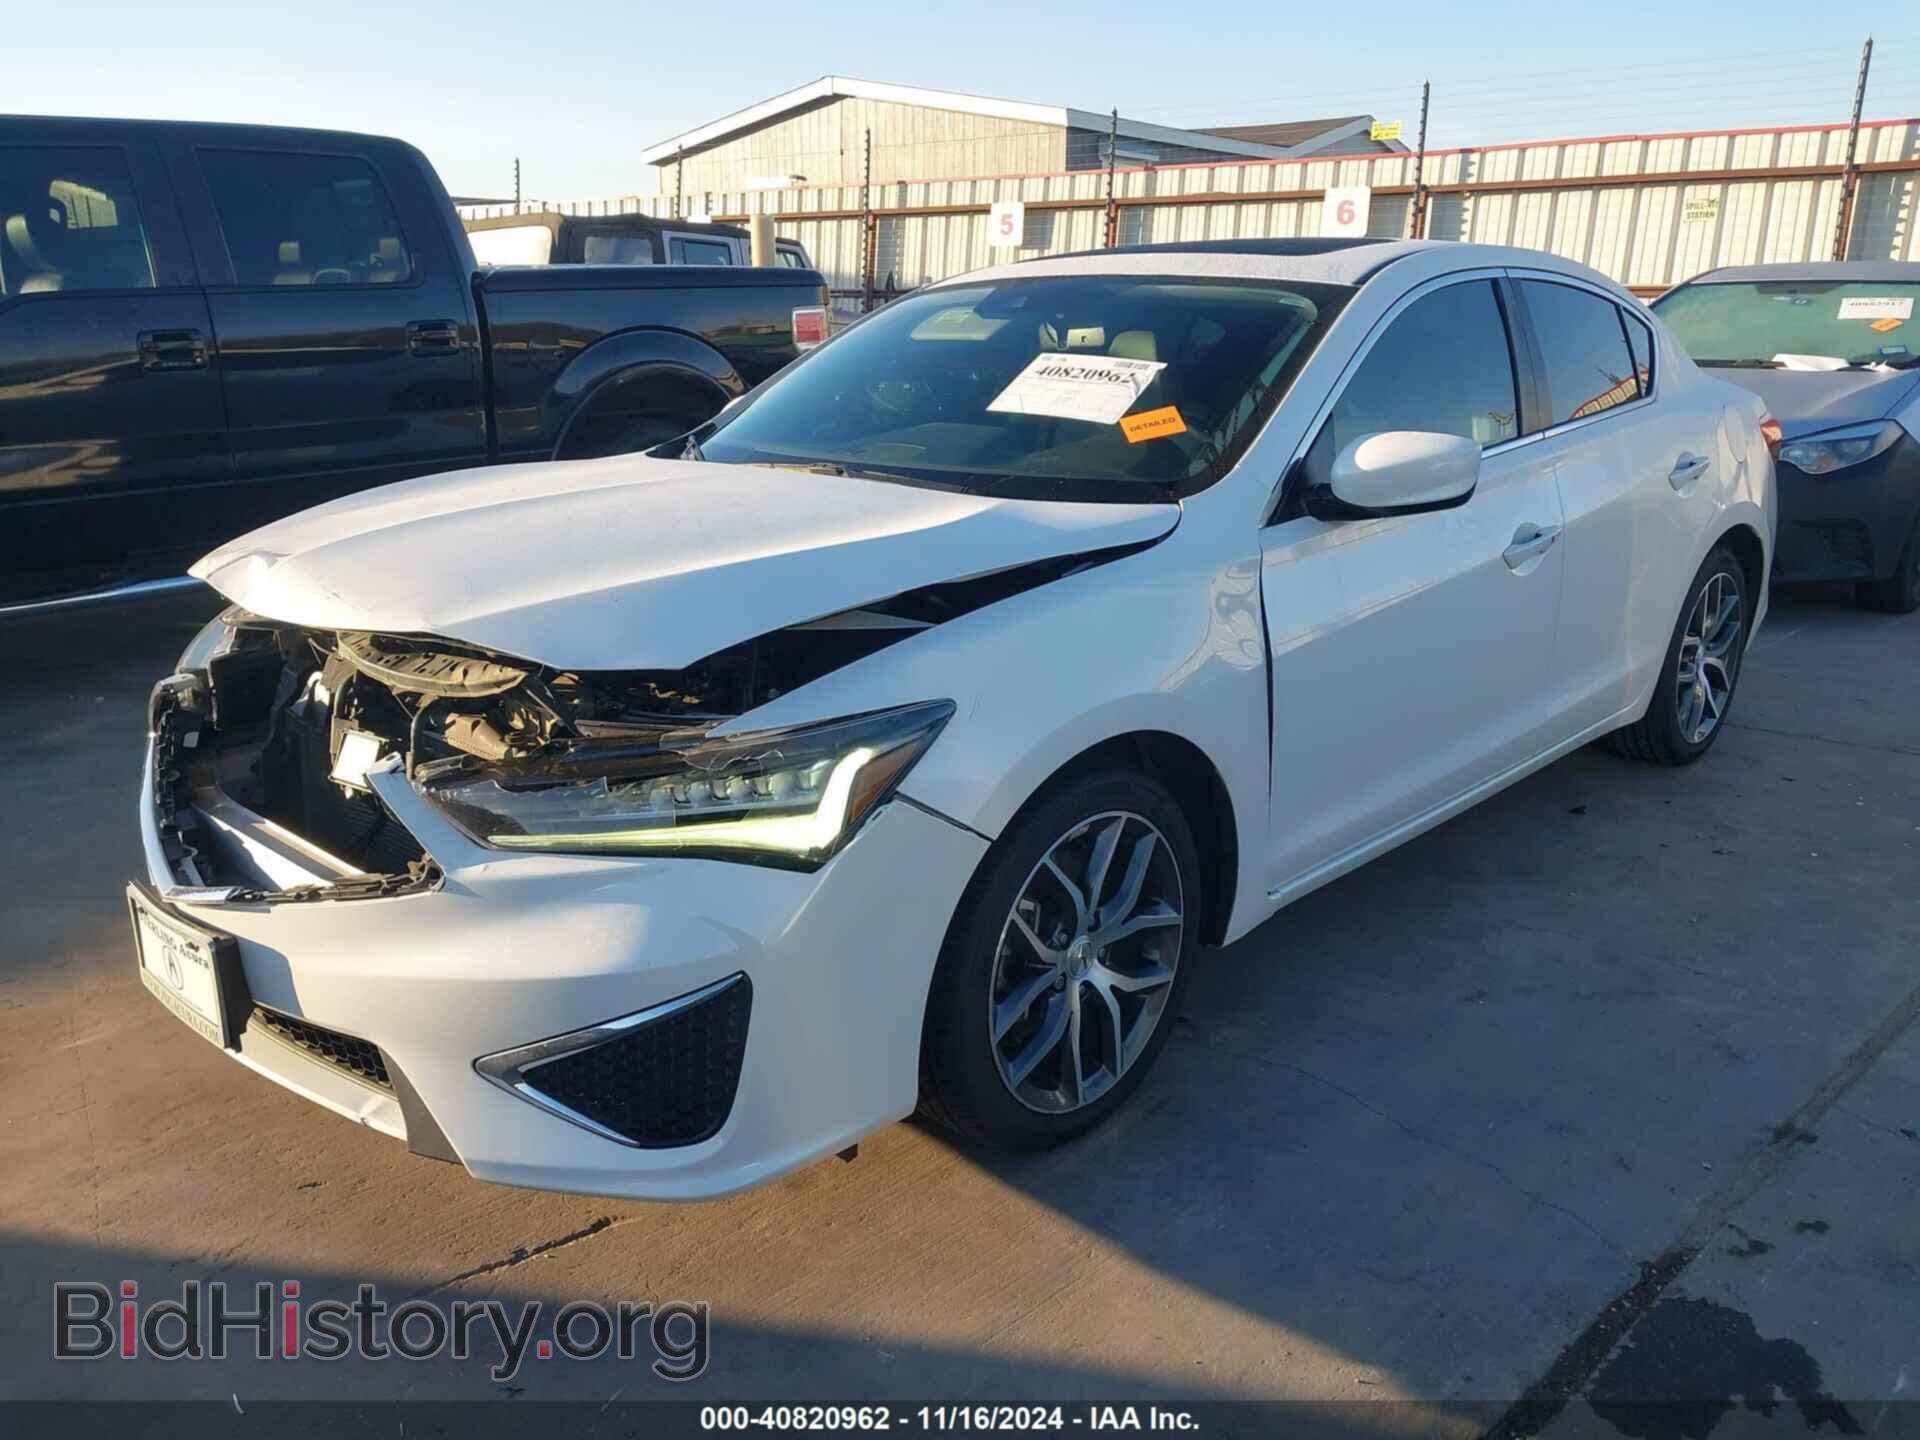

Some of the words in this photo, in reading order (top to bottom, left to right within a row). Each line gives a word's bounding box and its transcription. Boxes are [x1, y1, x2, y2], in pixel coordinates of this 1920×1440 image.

[1337, 200, 1355, 224] 6
[1000, 214, 1014, 236] 5
[1130, 416, 1176, 433] DETAILED
